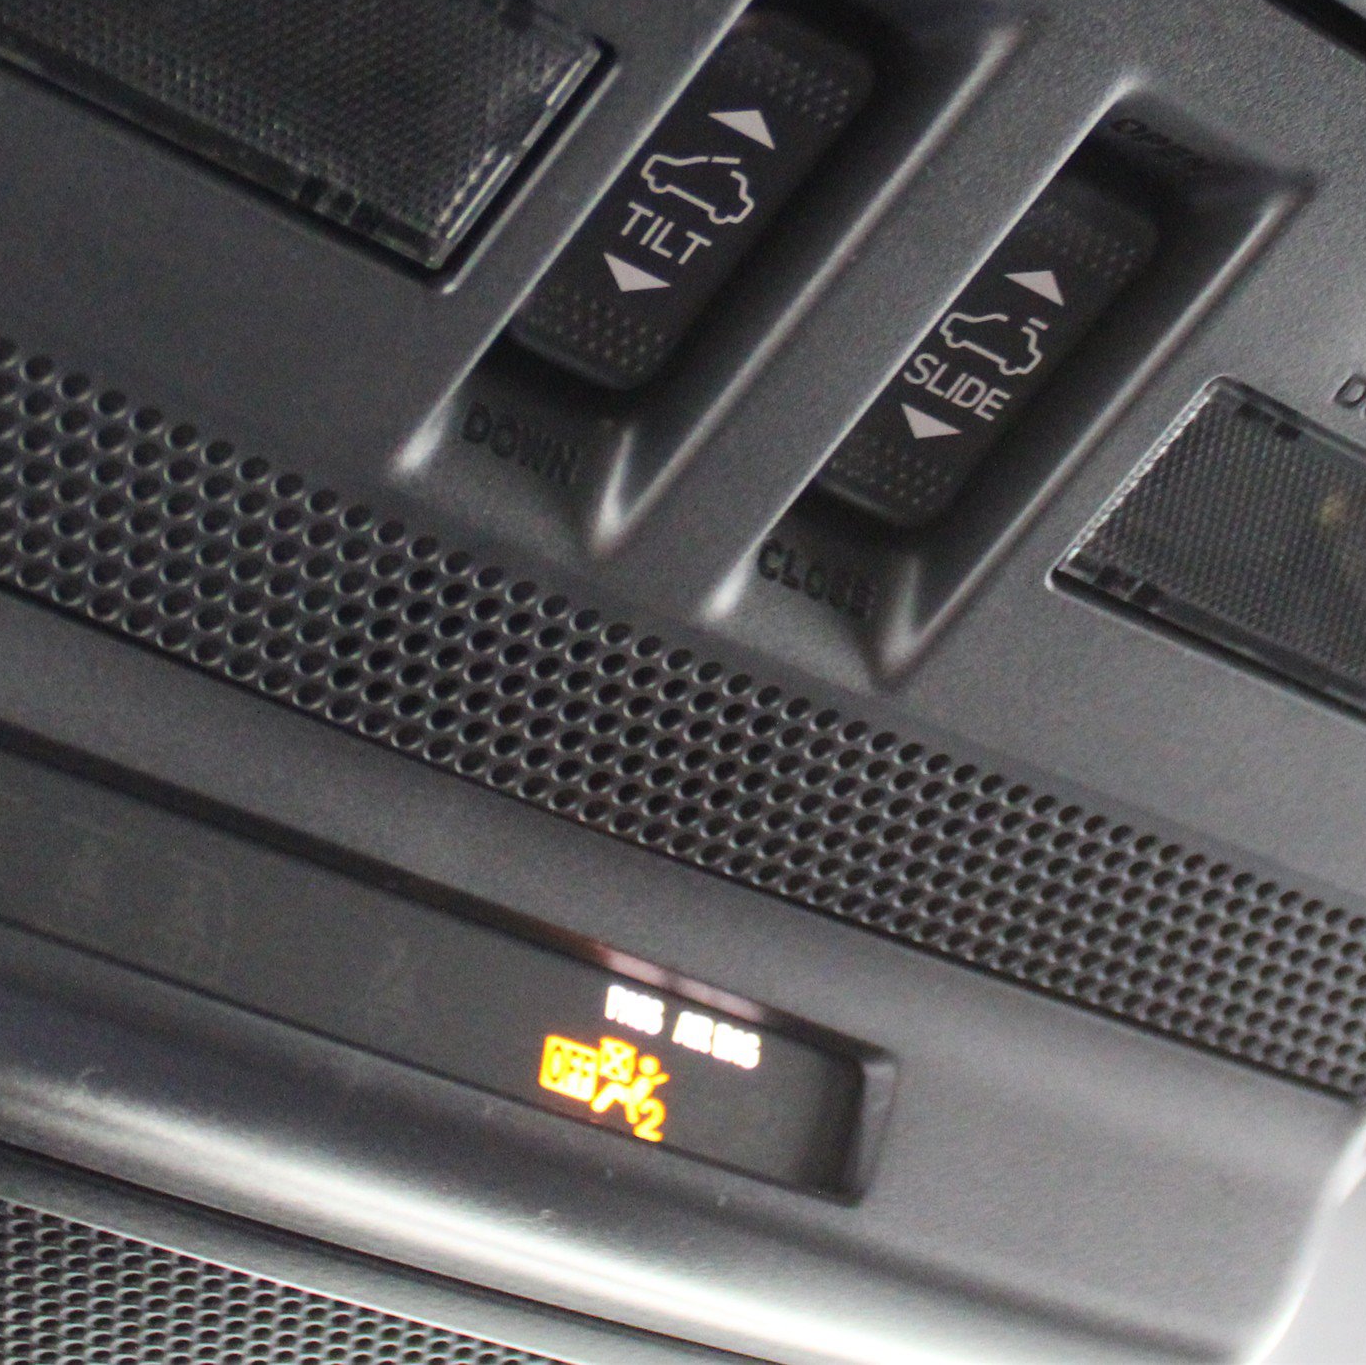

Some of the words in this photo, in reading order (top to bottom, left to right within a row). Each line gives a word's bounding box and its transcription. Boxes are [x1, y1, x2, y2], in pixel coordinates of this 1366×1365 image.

[621, 201, 712, 265] TILT
[904, 353, 1010, 421] SLIDE
[633, 1098, 667, 1143] 2
